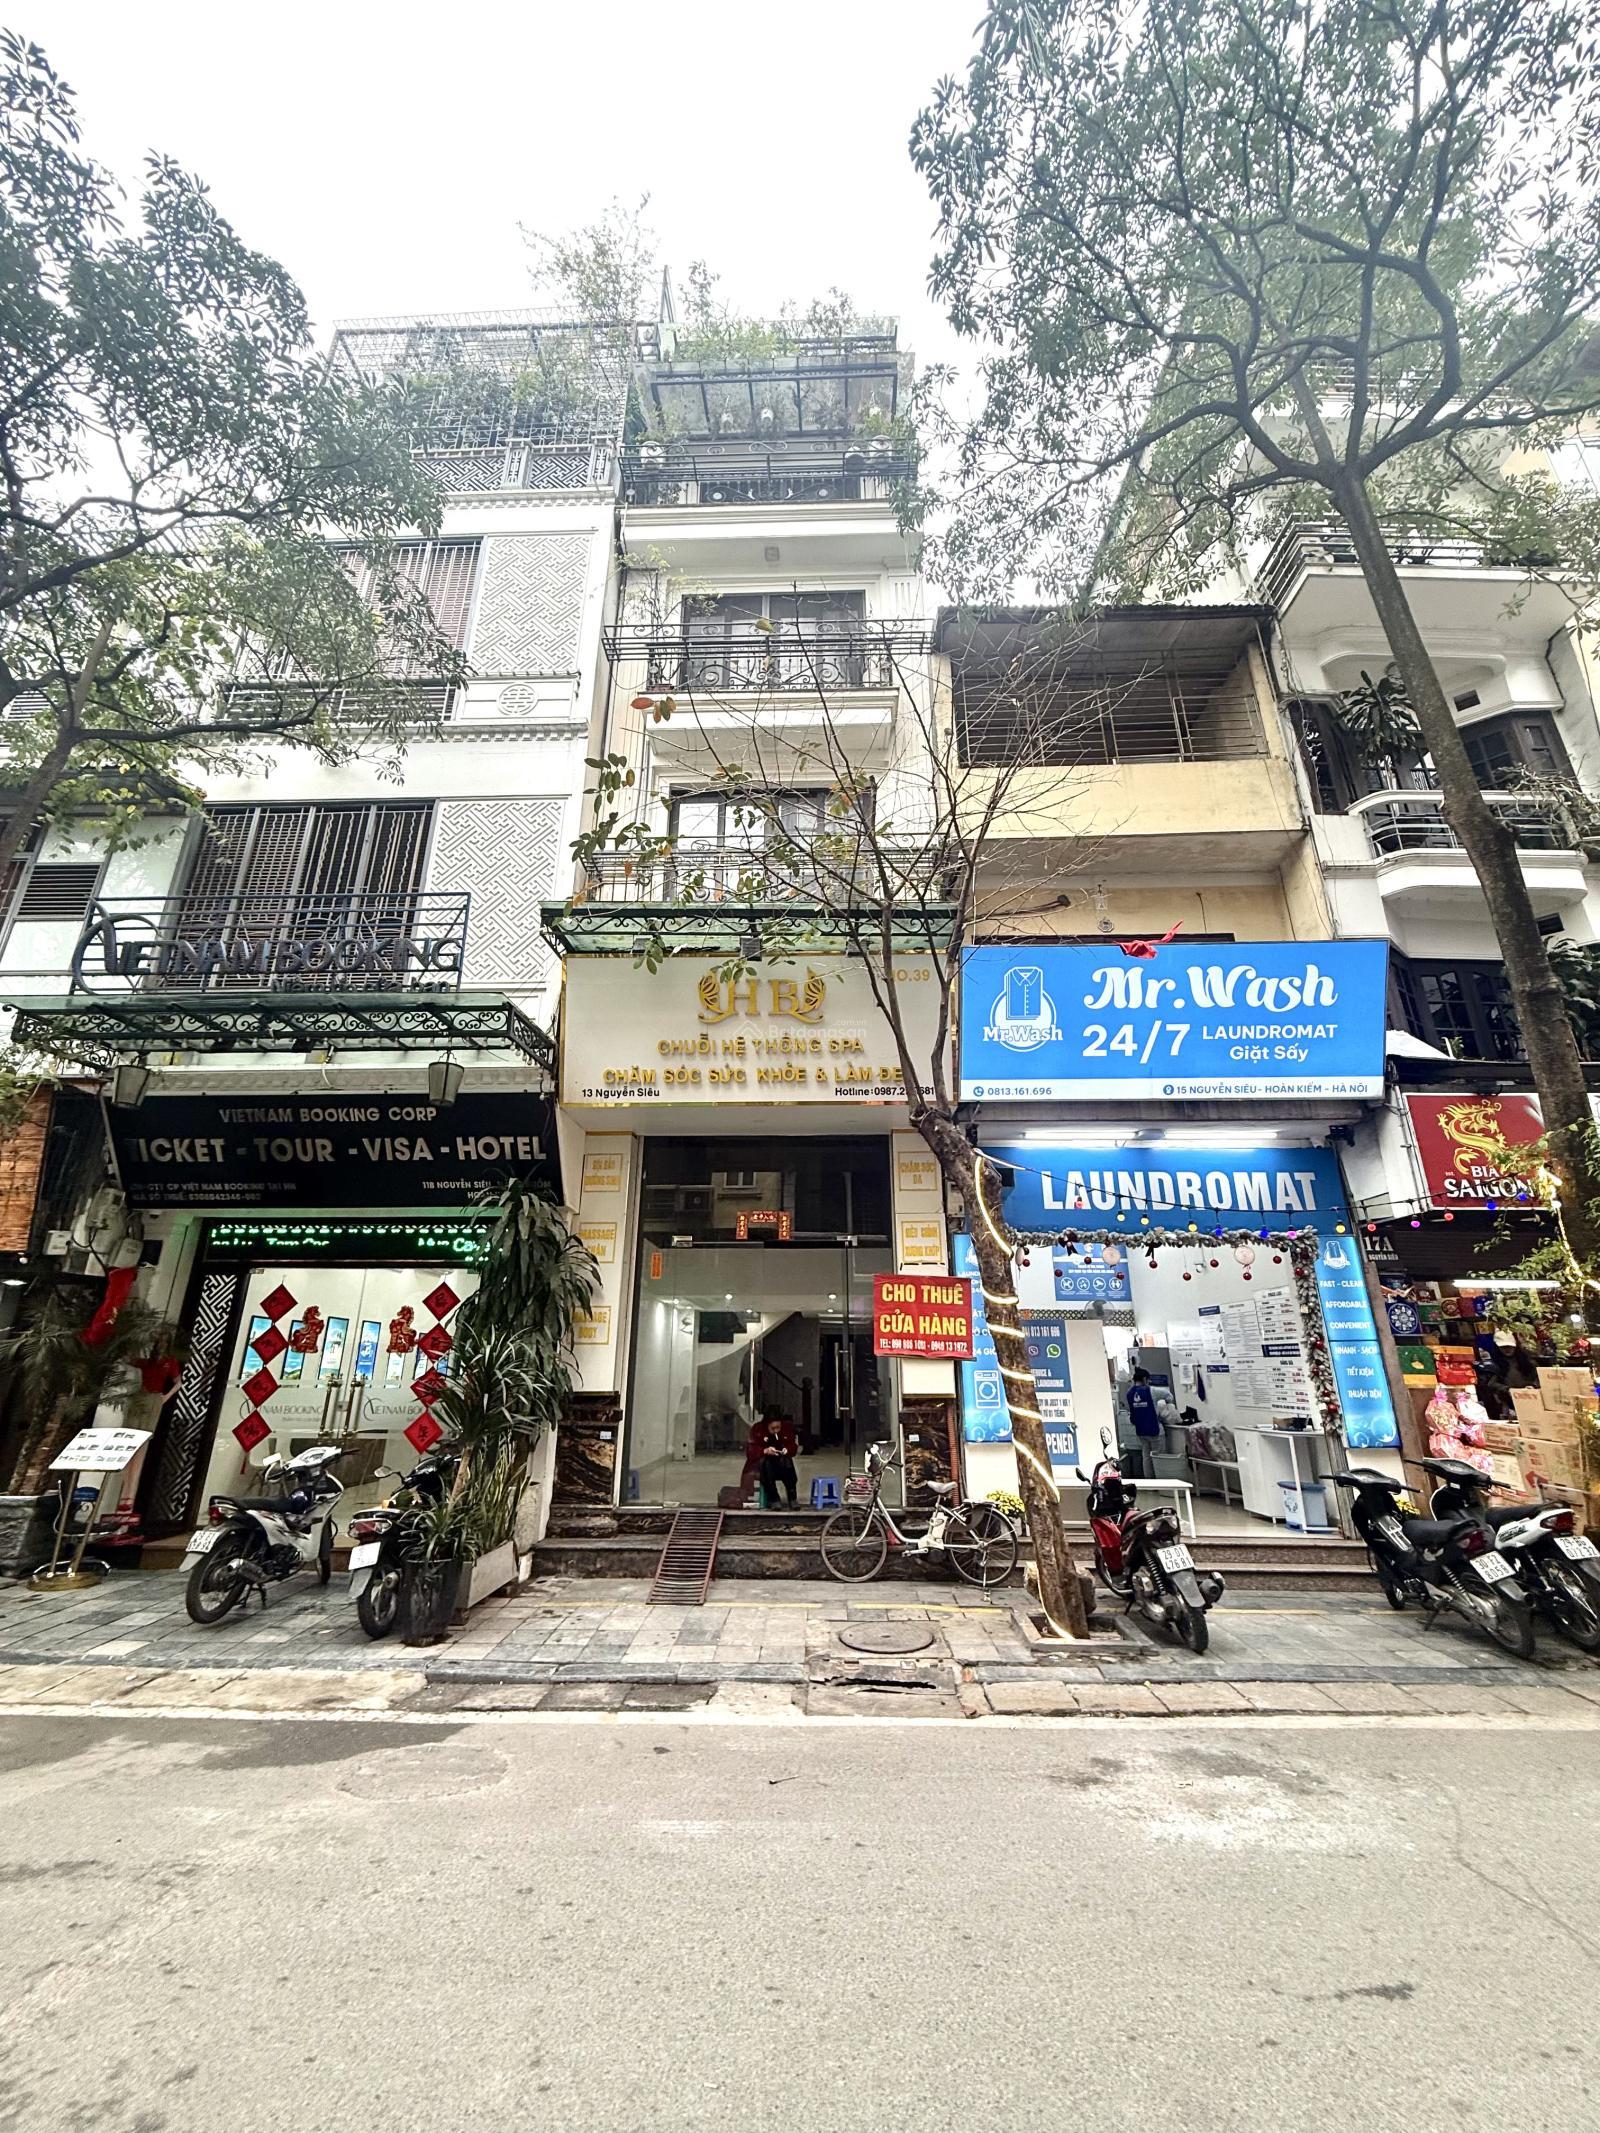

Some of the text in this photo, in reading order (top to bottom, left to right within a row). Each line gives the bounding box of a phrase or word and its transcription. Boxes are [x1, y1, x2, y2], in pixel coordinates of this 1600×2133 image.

[73, 898, 462, 990] VIETNAM BOOKING
[1083, 964, 1339, 1012] Mr.Wash
[983, 1025, 1063, 1042] Mr.Wash
[1082, 1020, 1338, 1064] 24/7 LAUNDROMAT
[829, 1039, 865, 1053] SPA
[1230, 1043, 1309, 1063] Giặt Sấy
[603, 1065, 656, 1084] CHĂM
[663, 1063, 700, 1083] SÓC
[815, 1067, 828, 1081] &
[834, 1062, 880, 1081] LÀM
[582, 1089, 592, 1098] 13
[595, 1084, 635, 1100] Nguyễn
[987, 1087, 1052, 1096] 0813.161.696
[1176, 1085, 1187, 1095] 15
[1189, 1081, 1230, 1095] NGUYỄN
[1265, 1082, 1295, 1094] HOÀN
[1332, 1082, 1347, 1093] HÀ
[1349, 1081, 1368, 1095] NỘI
[219, 1107, 437, 1122] VIETNAM BOOKING CORP
[253, 1137, 335, 1163] TOUR
[361, 1137, 434, 1161] VISA
[456, 1136, 547, 1160] HOTEL
[1471, 1165, 1500, 1178] BIA
[1041, 1170, 1318, 1211] LAUNDROMAT
[1363, 1236, 1394, 1251] 17A
[882, 1283, 964, 1305] CHO THUÊ
[880, 1309, 915, 1333] CỬA
[919, 1313, 967, 1336] HÀNG
[946, 1342, 952, 1352] 13
[1046, 1433, 1075, 1453] PENED
